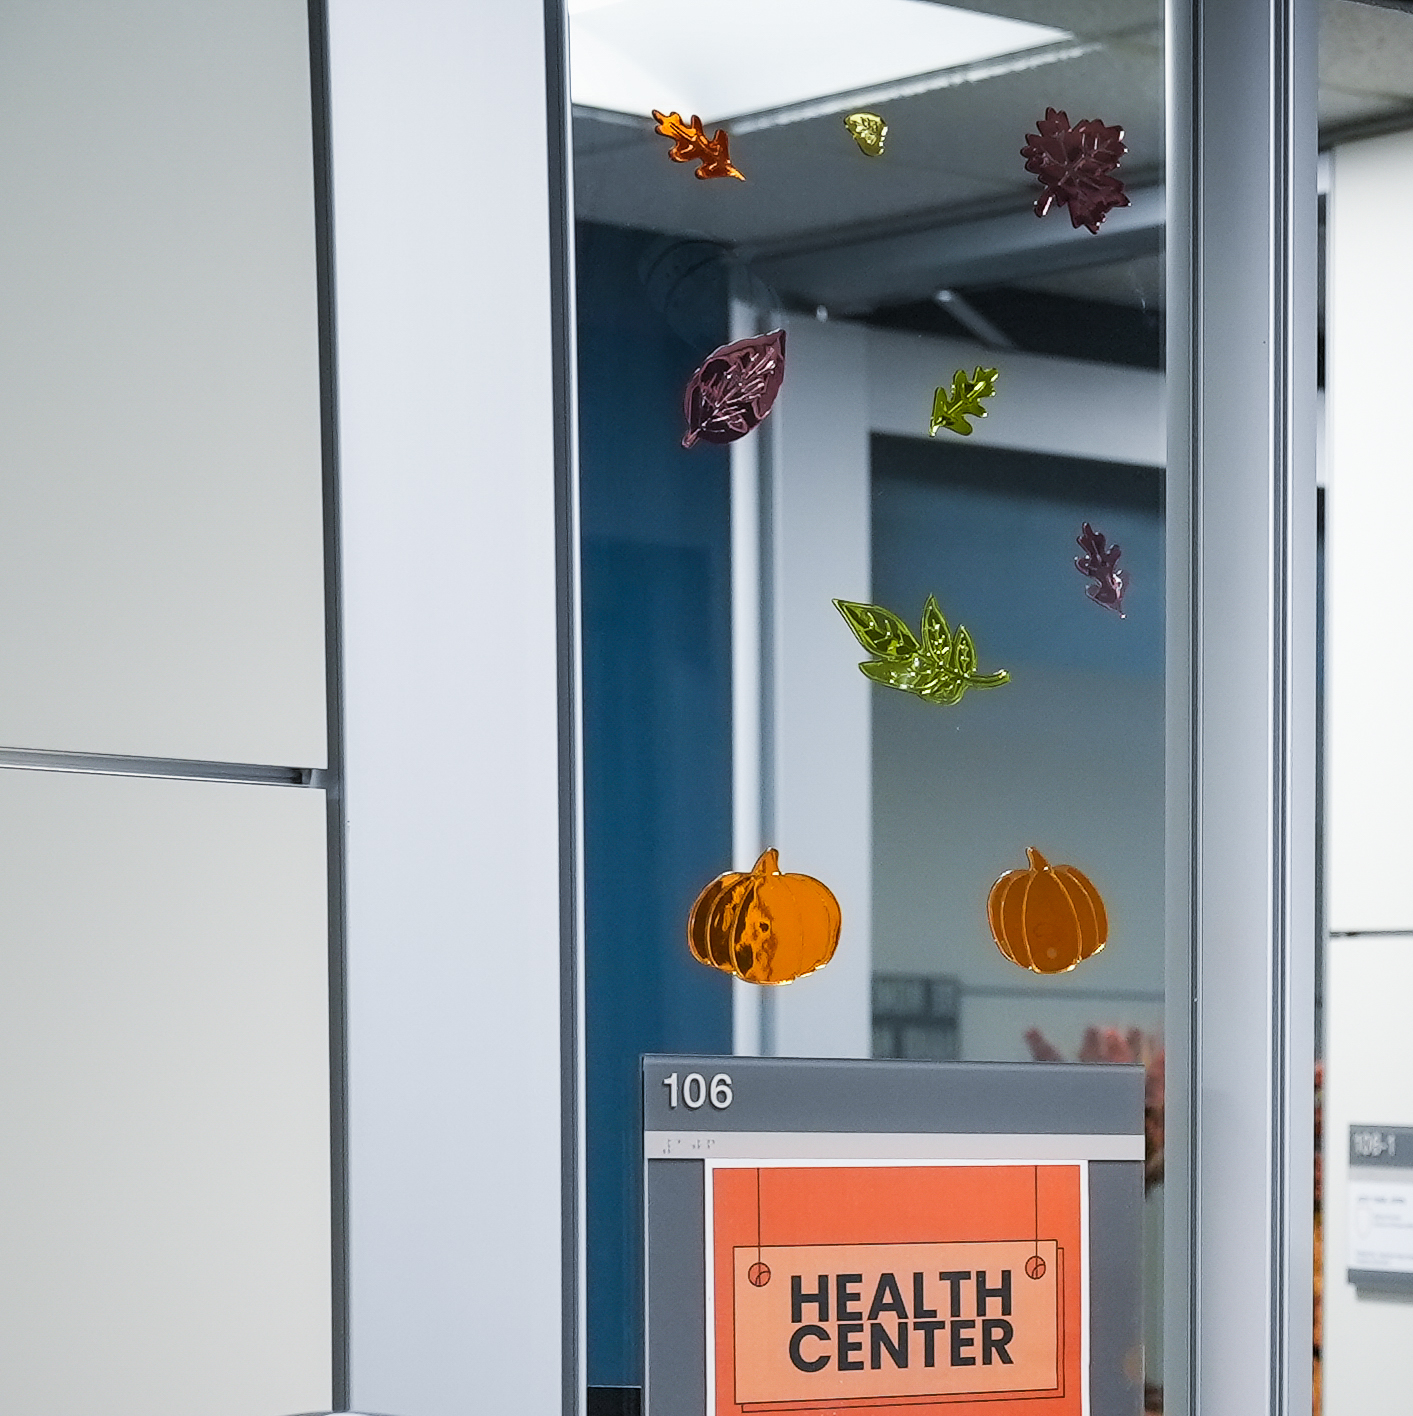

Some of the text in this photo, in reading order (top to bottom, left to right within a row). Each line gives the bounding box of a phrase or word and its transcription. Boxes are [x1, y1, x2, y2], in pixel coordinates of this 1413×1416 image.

[663, 1072, 733, 1109] 106
[790, 1269, 1012, 1323] HEALTH
[789, 1318, 1014, 1372] CENTER
